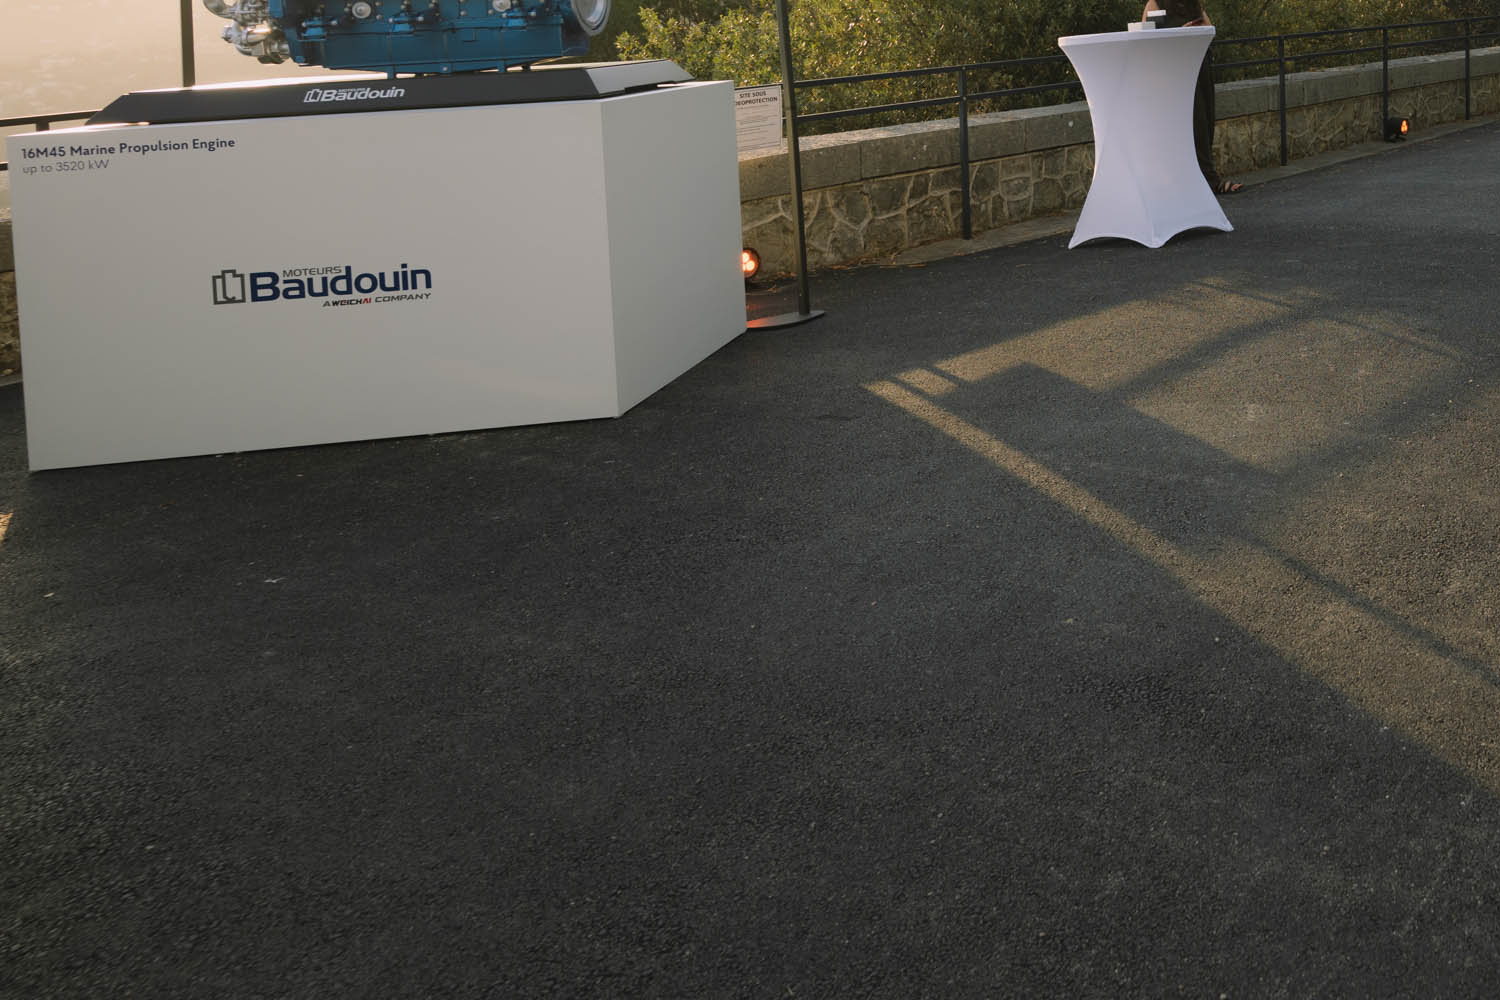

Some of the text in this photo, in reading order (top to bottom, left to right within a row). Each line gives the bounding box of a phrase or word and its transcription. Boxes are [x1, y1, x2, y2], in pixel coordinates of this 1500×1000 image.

[320, 86, 405, 102] Baudouin
[21, 137, 236, 160] 16M45 Marine Propulsion Engine
[22, 158, 110, 176] up to 3520 kW
[282, 265, 343, 278] MOTEURS
[249, 263, 432, 303] Baudouin
[374, 292, 432, 304] COMPANY
